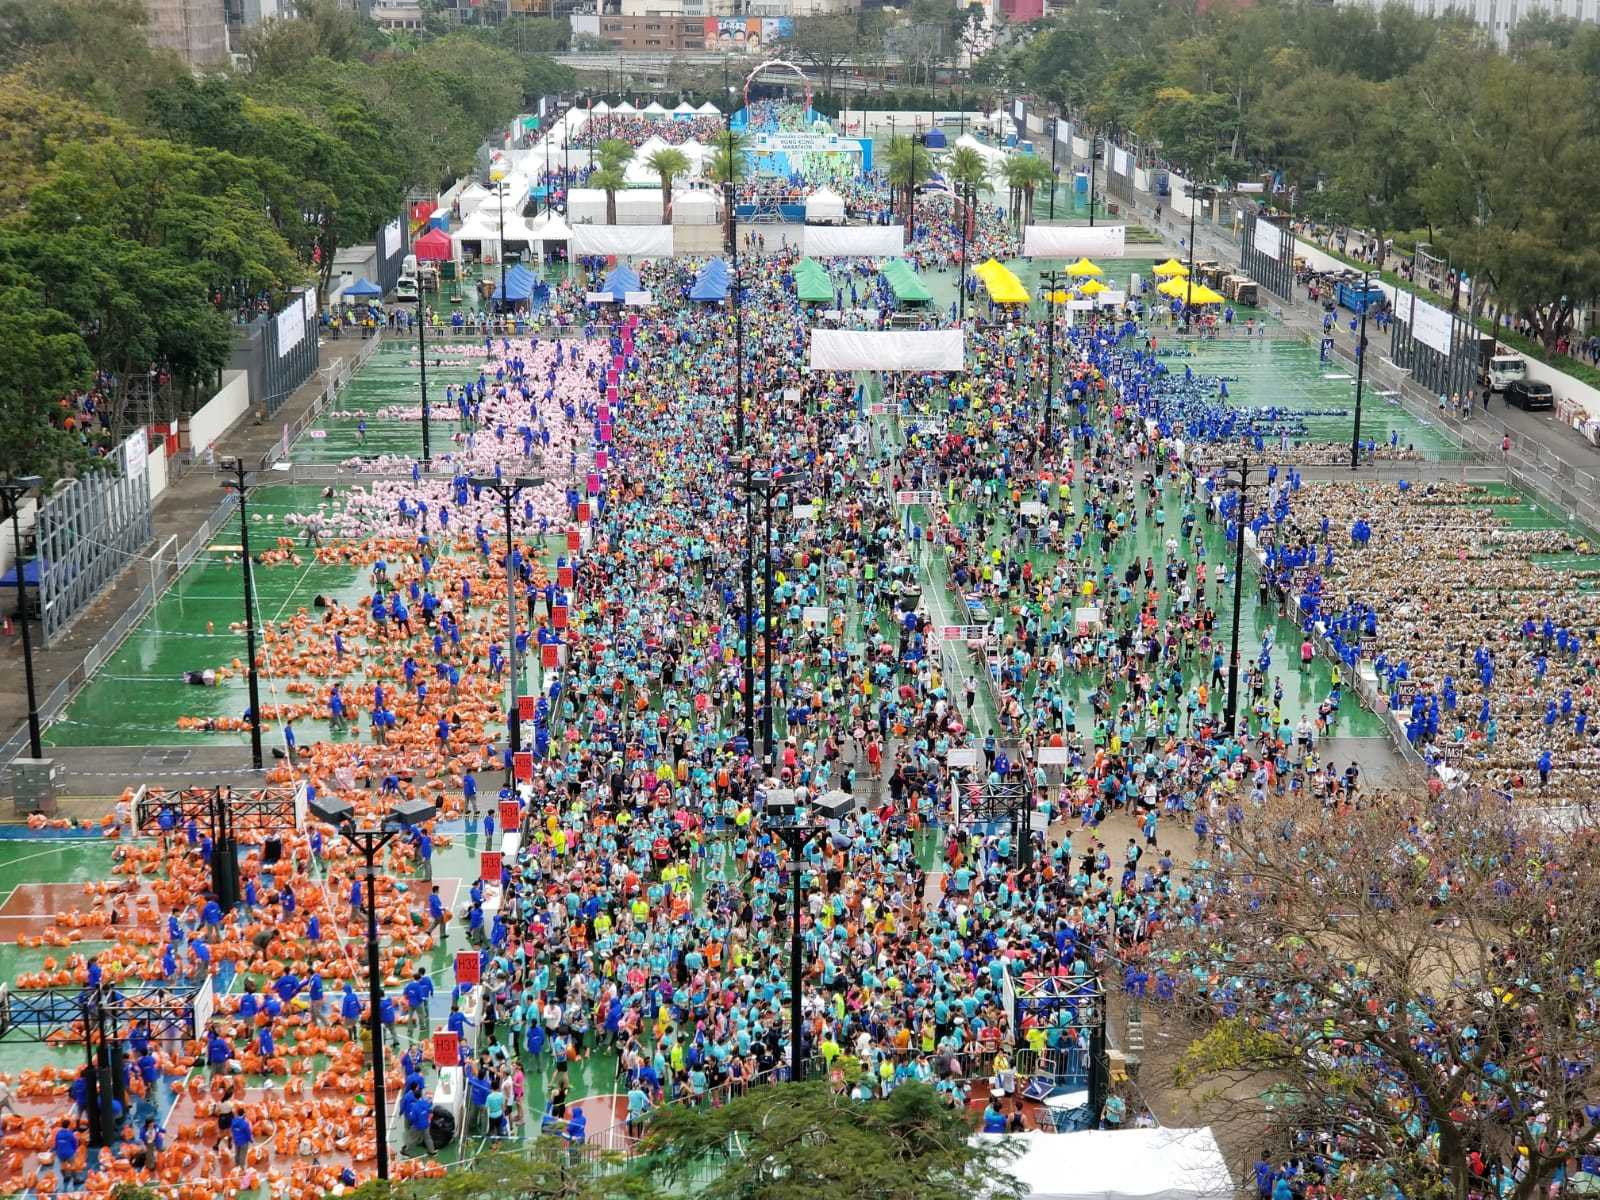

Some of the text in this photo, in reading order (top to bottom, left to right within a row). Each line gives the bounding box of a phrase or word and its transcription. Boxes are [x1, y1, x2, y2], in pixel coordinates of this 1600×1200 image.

[1322, 600, 1335, 608] M34
[1361, 642, 1376, 650] M33
[1400, 686, 1416, 695] M32
[1447, 748, 1463, 757] M31
[458, 958, 477, 970] H32
[436, 1038, 456, 1051] H31
